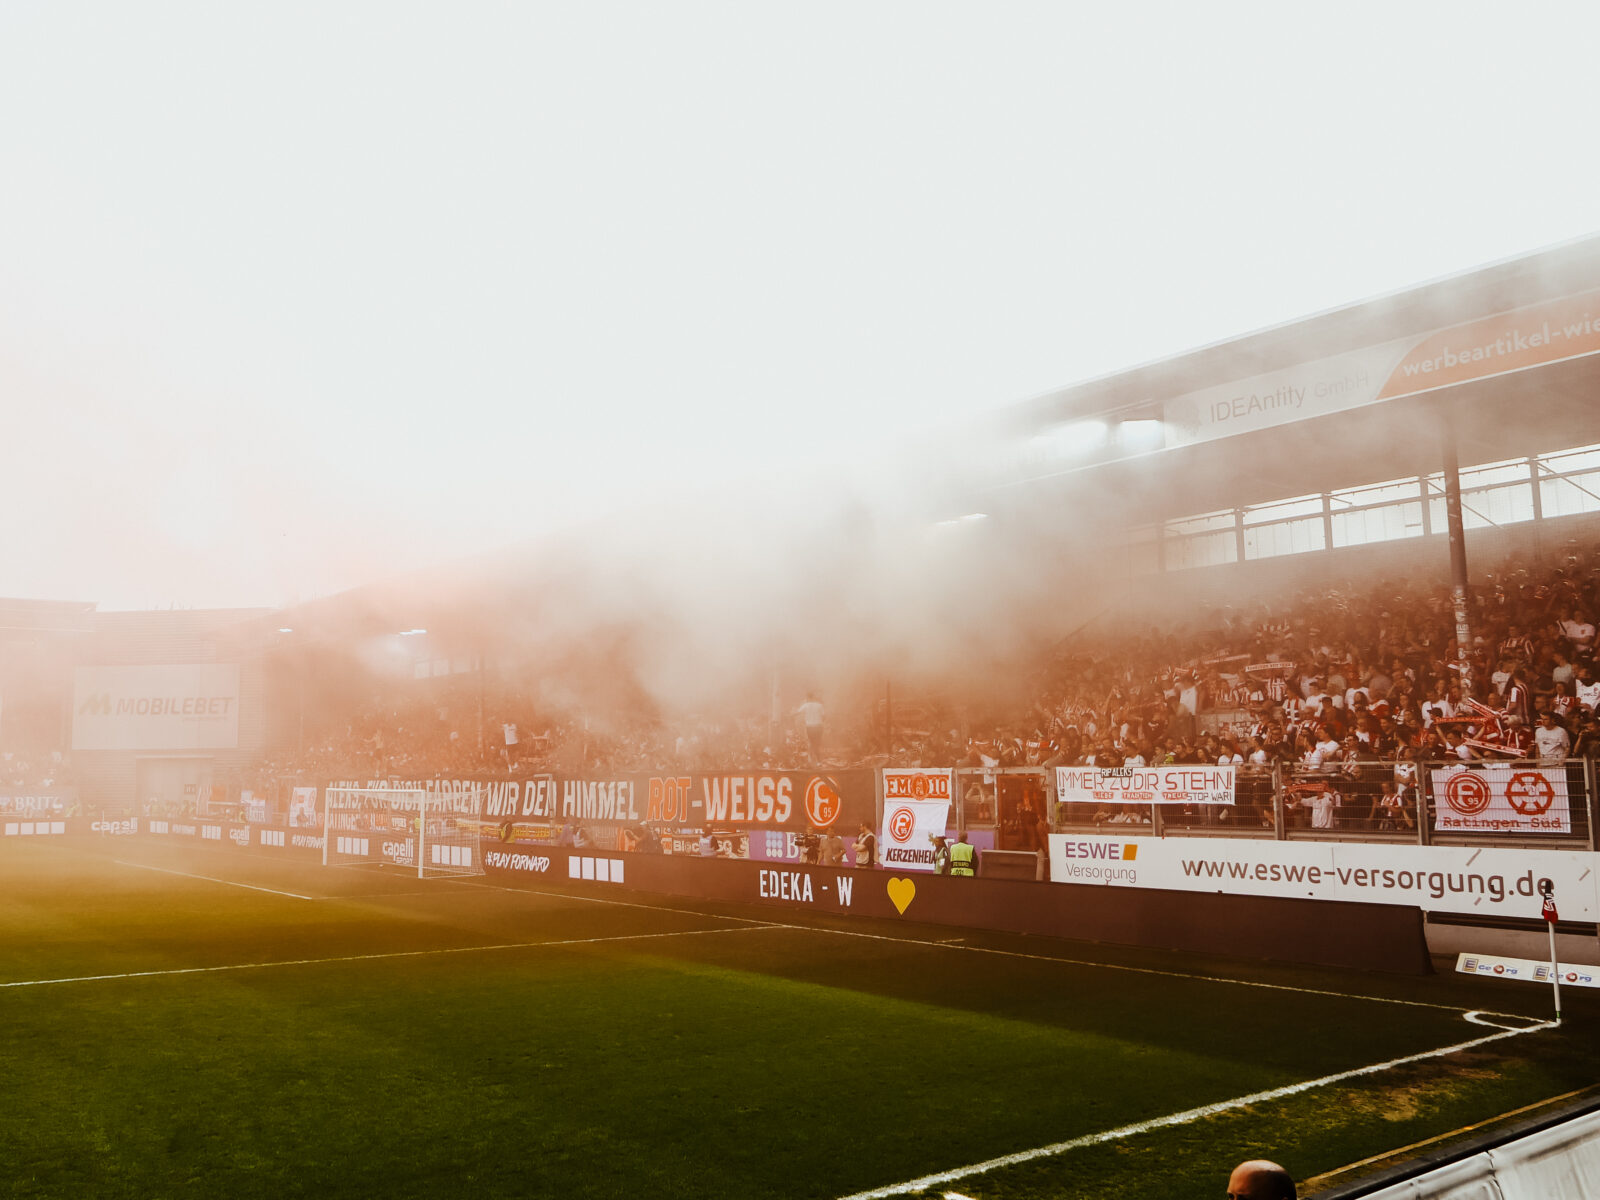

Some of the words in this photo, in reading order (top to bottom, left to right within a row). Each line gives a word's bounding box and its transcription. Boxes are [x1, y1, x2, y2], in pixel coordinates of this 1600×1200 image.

[1209, 384, 1307, 424] IDEAntity
[116, 697, 234, 716] MOBILEBET
[1058, 771, 1104, 790] IMMER
[1110, 776, 1131, 791] ZU
[1134, 773, 1159, 791] DIR
[1165, 771, 1232, 790] STEHN!
[1101, 768, 1112, 777] RIP
[1112, 768, 1132, 777] ALEKS
[930, 777, 948, 797] 10
[1187, 792, 1209, 801] STOP
[487, 781, 520, 816] WIR
[522, 780, 558, 817] DEN
[562, 779, 639, 820] HIMMEL
[647, 776, 792, 823] ROT-WEISS
[382, 838, 414, 862] capelli
[1065, 842, 1120, 859] ESWE
[485, 851, 511, 869] #PLAY
[510, 853, 550, 873] FORWARD
[1066, 863, 1137, 883] Versorgung
[1181, 860, 1555, 902] www.eswe-versorgung.de
[759, 869, 813, 902] EDEKA
[837, 876, 853, 906] W
